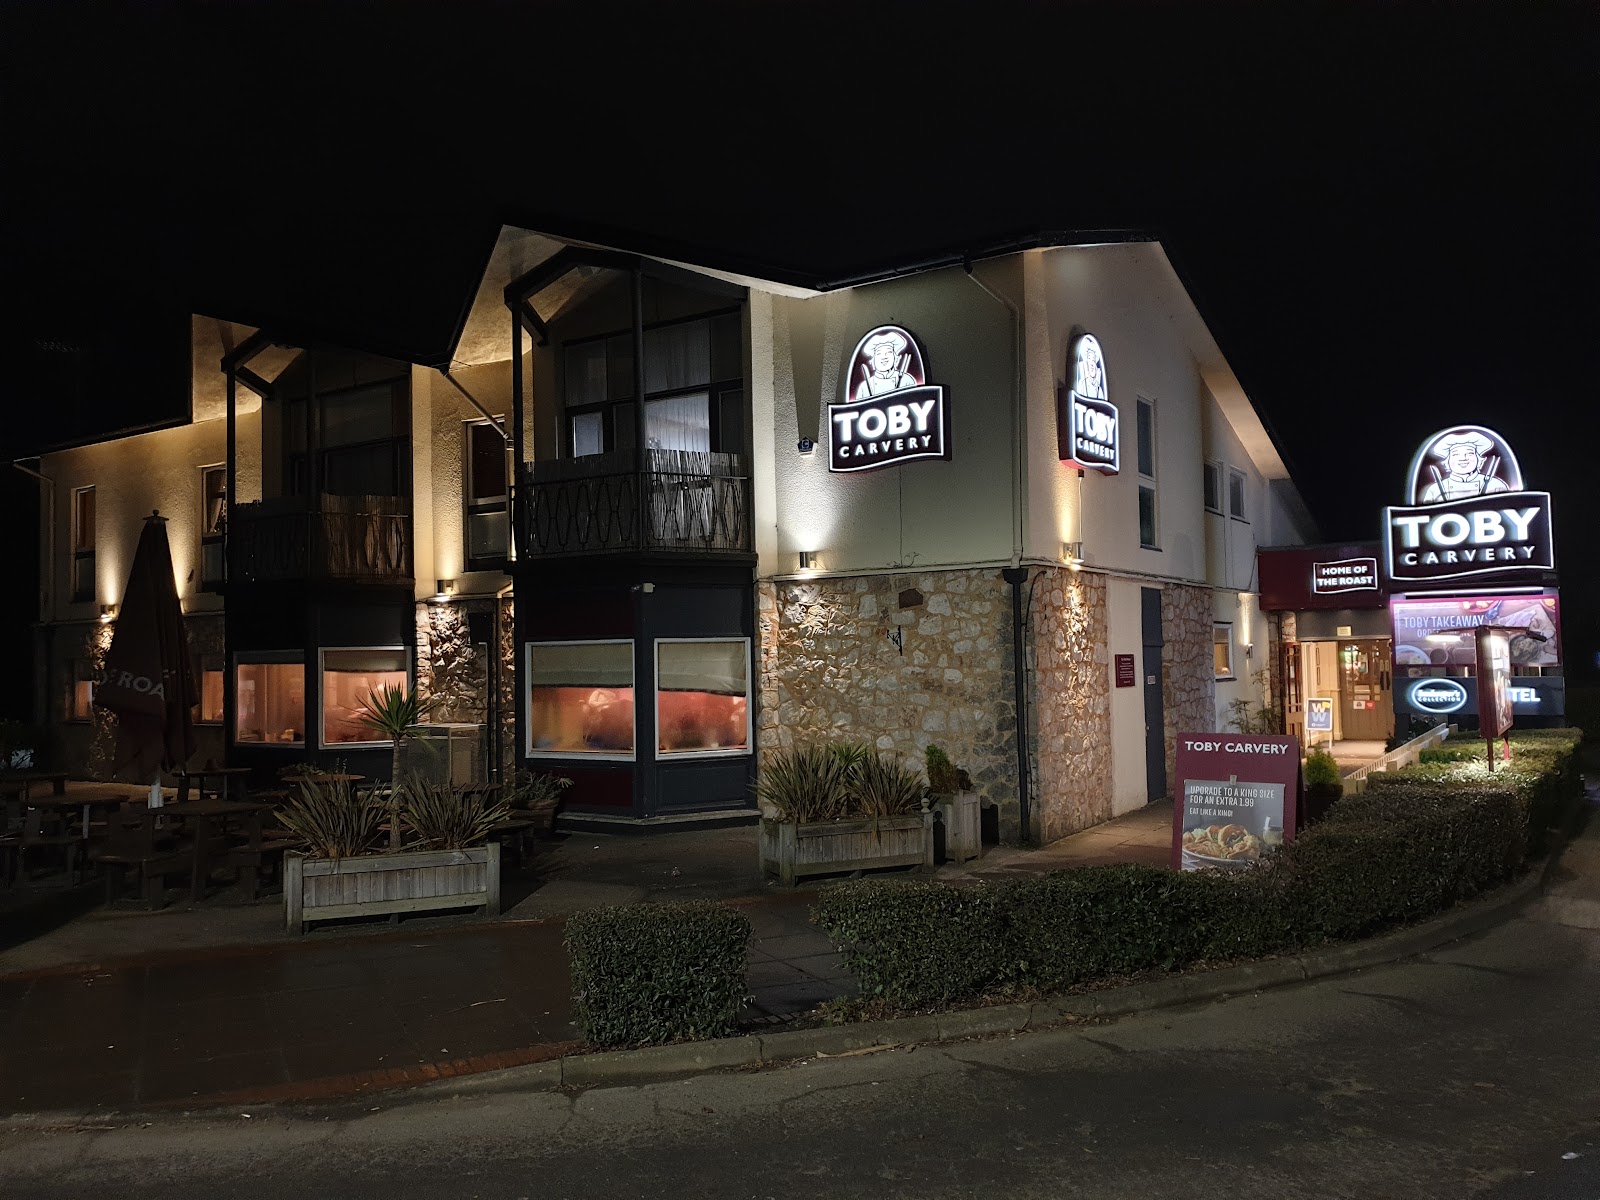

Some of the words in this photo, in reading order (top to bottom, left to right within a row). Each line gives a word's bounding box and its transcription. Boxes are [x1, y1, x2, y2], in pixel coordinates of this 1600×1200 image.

[834, 400, 936, 441] TOBY
[1075, 402, 1116, 445] TOBY
[839, 435, 931, 458] CARVERY
[1077, 437, 1115, 460] CARVERY
[1394, 507, 1540, 547] TOBY
[1404, 546, 1535, 566] CARVERY
[1322, 567, 1351, 575] HOME
[1353, 566, 1367, 574] OF
[1317, 578, 1338, 586] THE
[1339, 576, 1373, 585] ROAST
[1404, 617, 1429, 628] TOBY
[1430, 615, 1484, 628] TAKEAWAY
[1185, 741, 1221, 752] TOBY
[1225, 743, 1288, 754] CARVERY
[1190, 786, 1222, 796] UPGRADE
[1224, 787, 1232, 796] TO
[1233, 788, 1239, 797] A
[1240, 788, 1258, 798] KING
[1259, 789, 1275, 799] SIZE
[1190, 795, 1203, 804] FOR
[1204, 796, 1214, 805] AN
[1216, 796, 1238, 806] EXTRA
[1239, 798, 1254, 807] 1.99
[1200, 808, 1211, 816] LIKE
